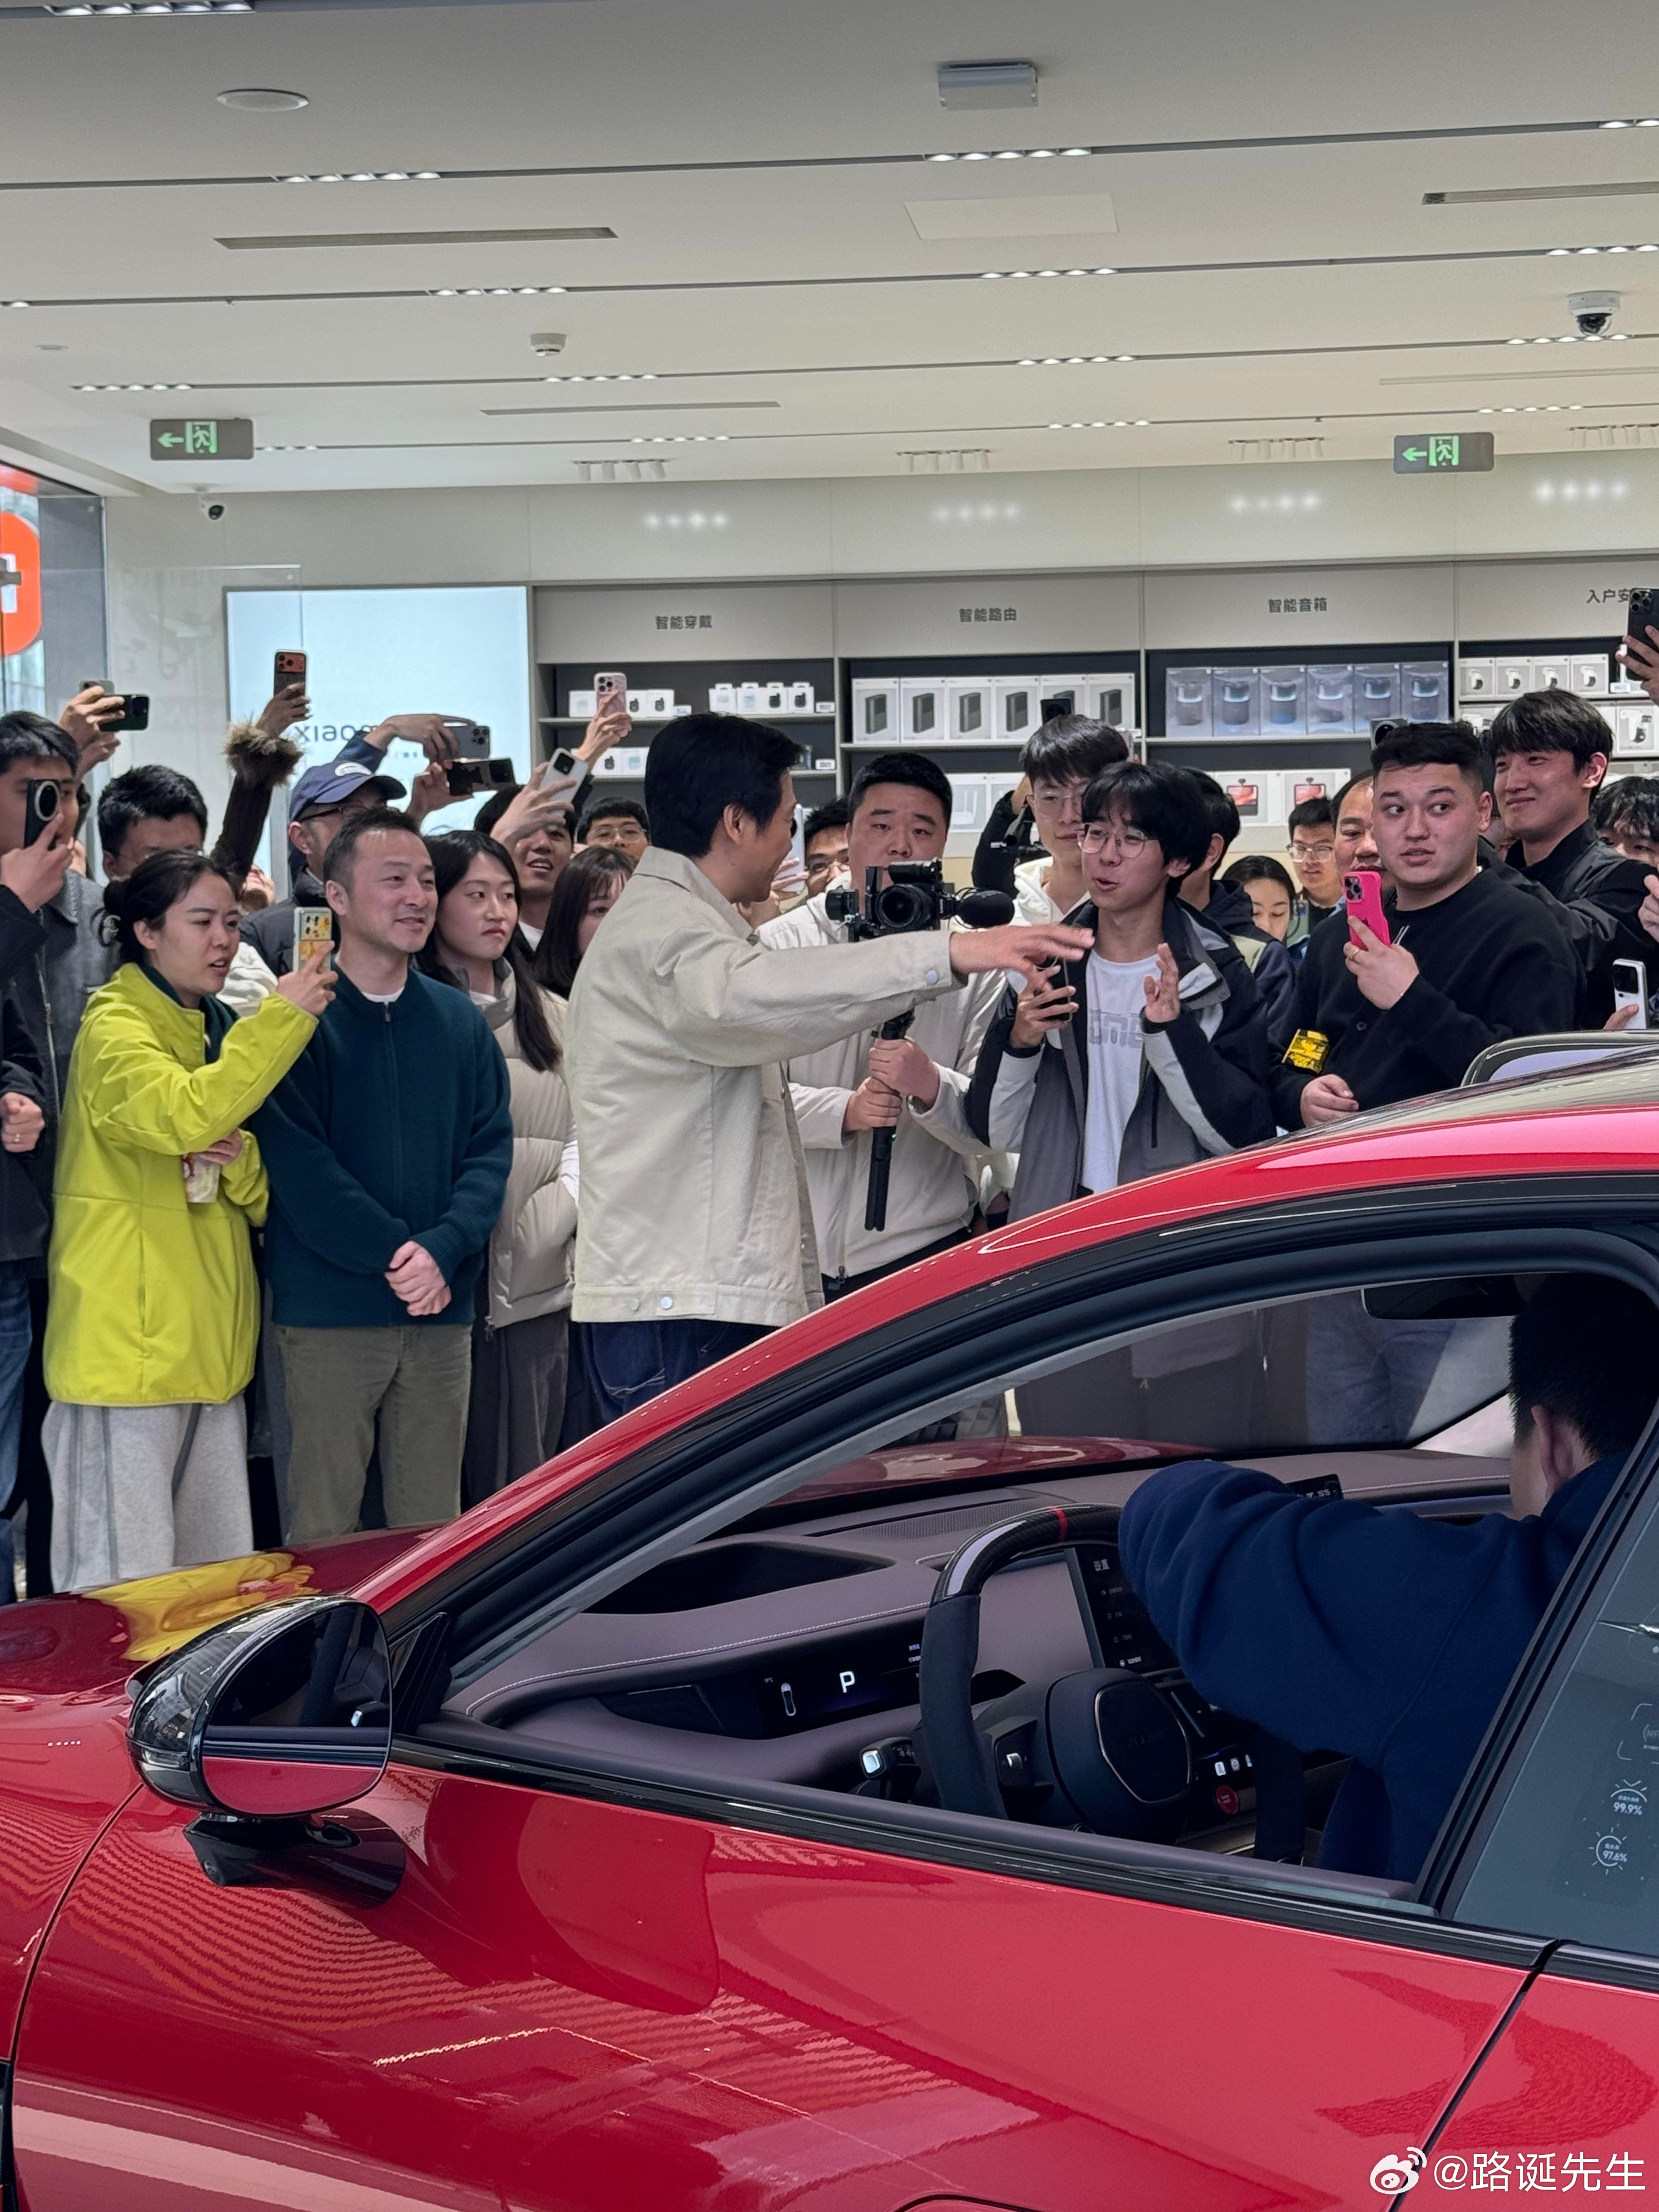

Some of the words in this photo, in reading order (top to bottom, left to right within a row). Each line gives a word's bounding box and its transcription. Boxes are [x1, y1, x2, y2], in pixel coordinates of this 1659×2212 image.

[1268, 597, 1327, 613] 智能音箱
[656, 615, 713, 630] 智能穿戴
[959, 607, 1017, 623] 智能路由
[839, 1671, 855, 1693] P
[1613, 1802, 1642, 1816] 99.9%
